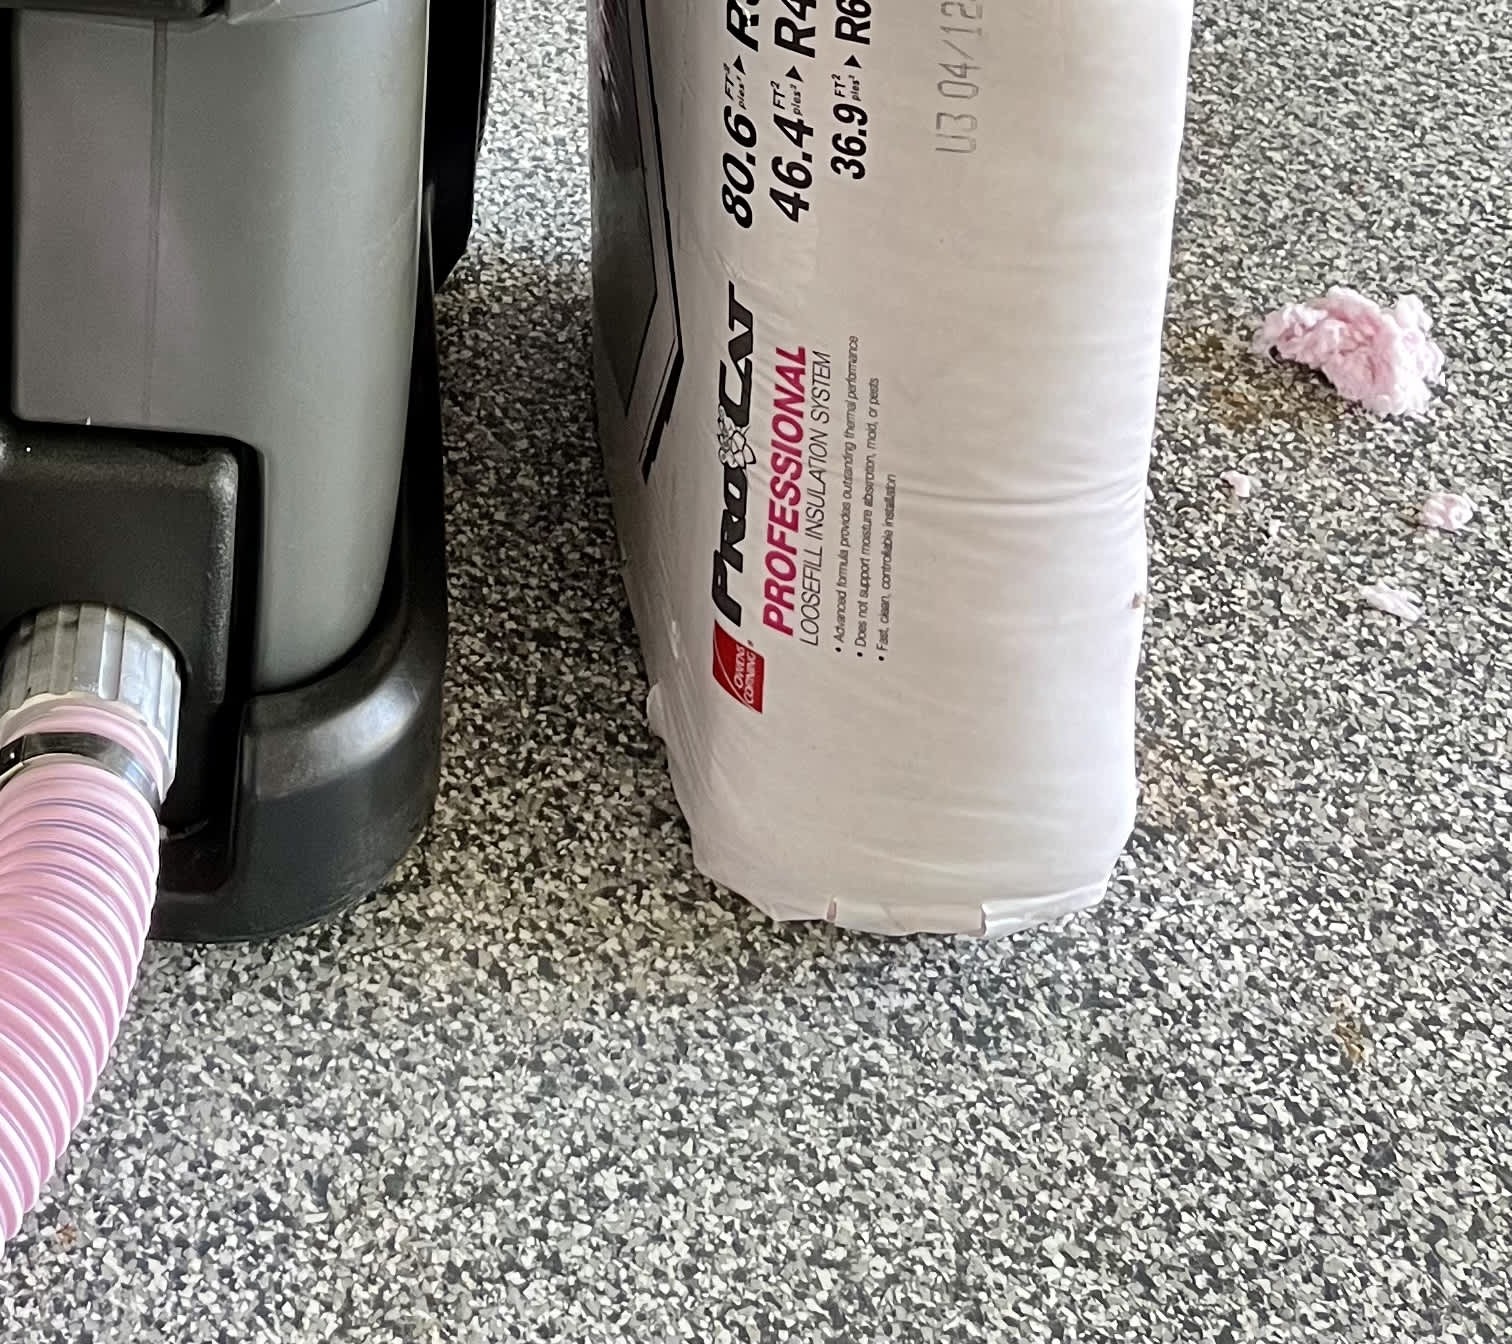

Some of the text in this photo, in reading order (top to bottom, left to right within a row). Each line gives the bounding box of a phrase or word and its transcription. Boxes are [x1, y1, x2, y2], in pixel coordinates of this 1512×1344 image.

[830, 102, 868, 180] 36.9
[722, 105, 757, 229] 80.6
[769, 113, 814, 224] 46.4
[844, 335, 860, 400] performance
[868, 377, 881, 406] pests
[844, 400, 857, 439] thermal
[868, 406, 879, 418] or
[763, 345, 807, 637] PROFESSIONAL
[800, 350, 832, 647] LOOSEFILL INSULATION SYSTEM
[882, 474, 897, 527] installation
[839, 502, 853, 547] provides
[861, 509, 874, 556] moisture
[836, 549, 850, 588] formula
[858, 558, 873, 599] support
[879, 530, 894, 590] controllable
[834, 590, 847, 644] Advanced
[855, 620, 868, 647] Does
[857, 601, 869, 618] not
